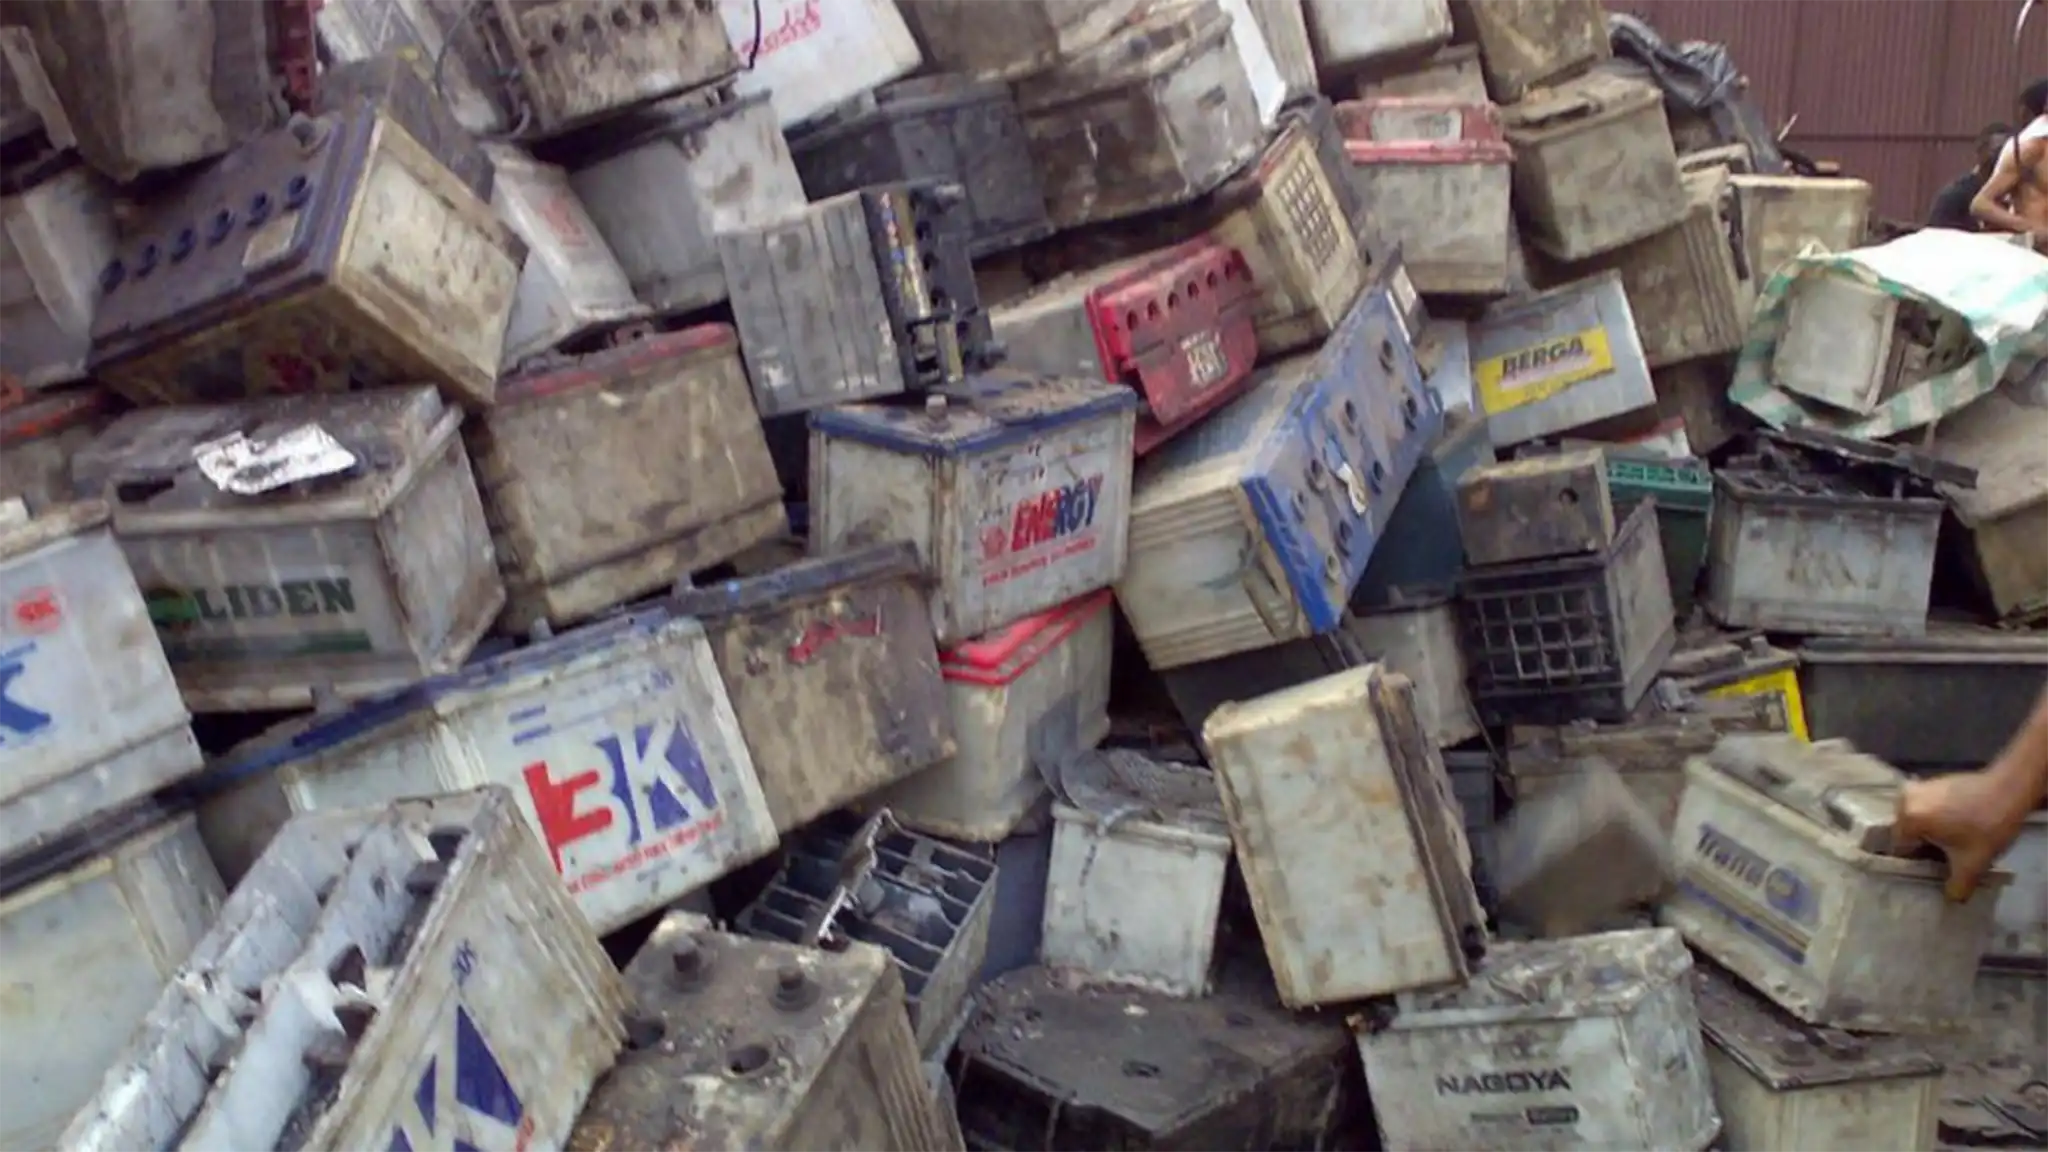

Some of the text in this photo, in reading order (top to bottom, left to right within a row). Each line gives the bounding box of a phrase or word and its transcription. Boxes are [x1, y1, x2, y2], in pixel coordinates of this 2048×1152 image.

[1500, 335, 1587, 381] BERGA
[1010, 471, 1104, 553] ENERGY
[1435, 1064, 1573, 1096] NAGOYA
